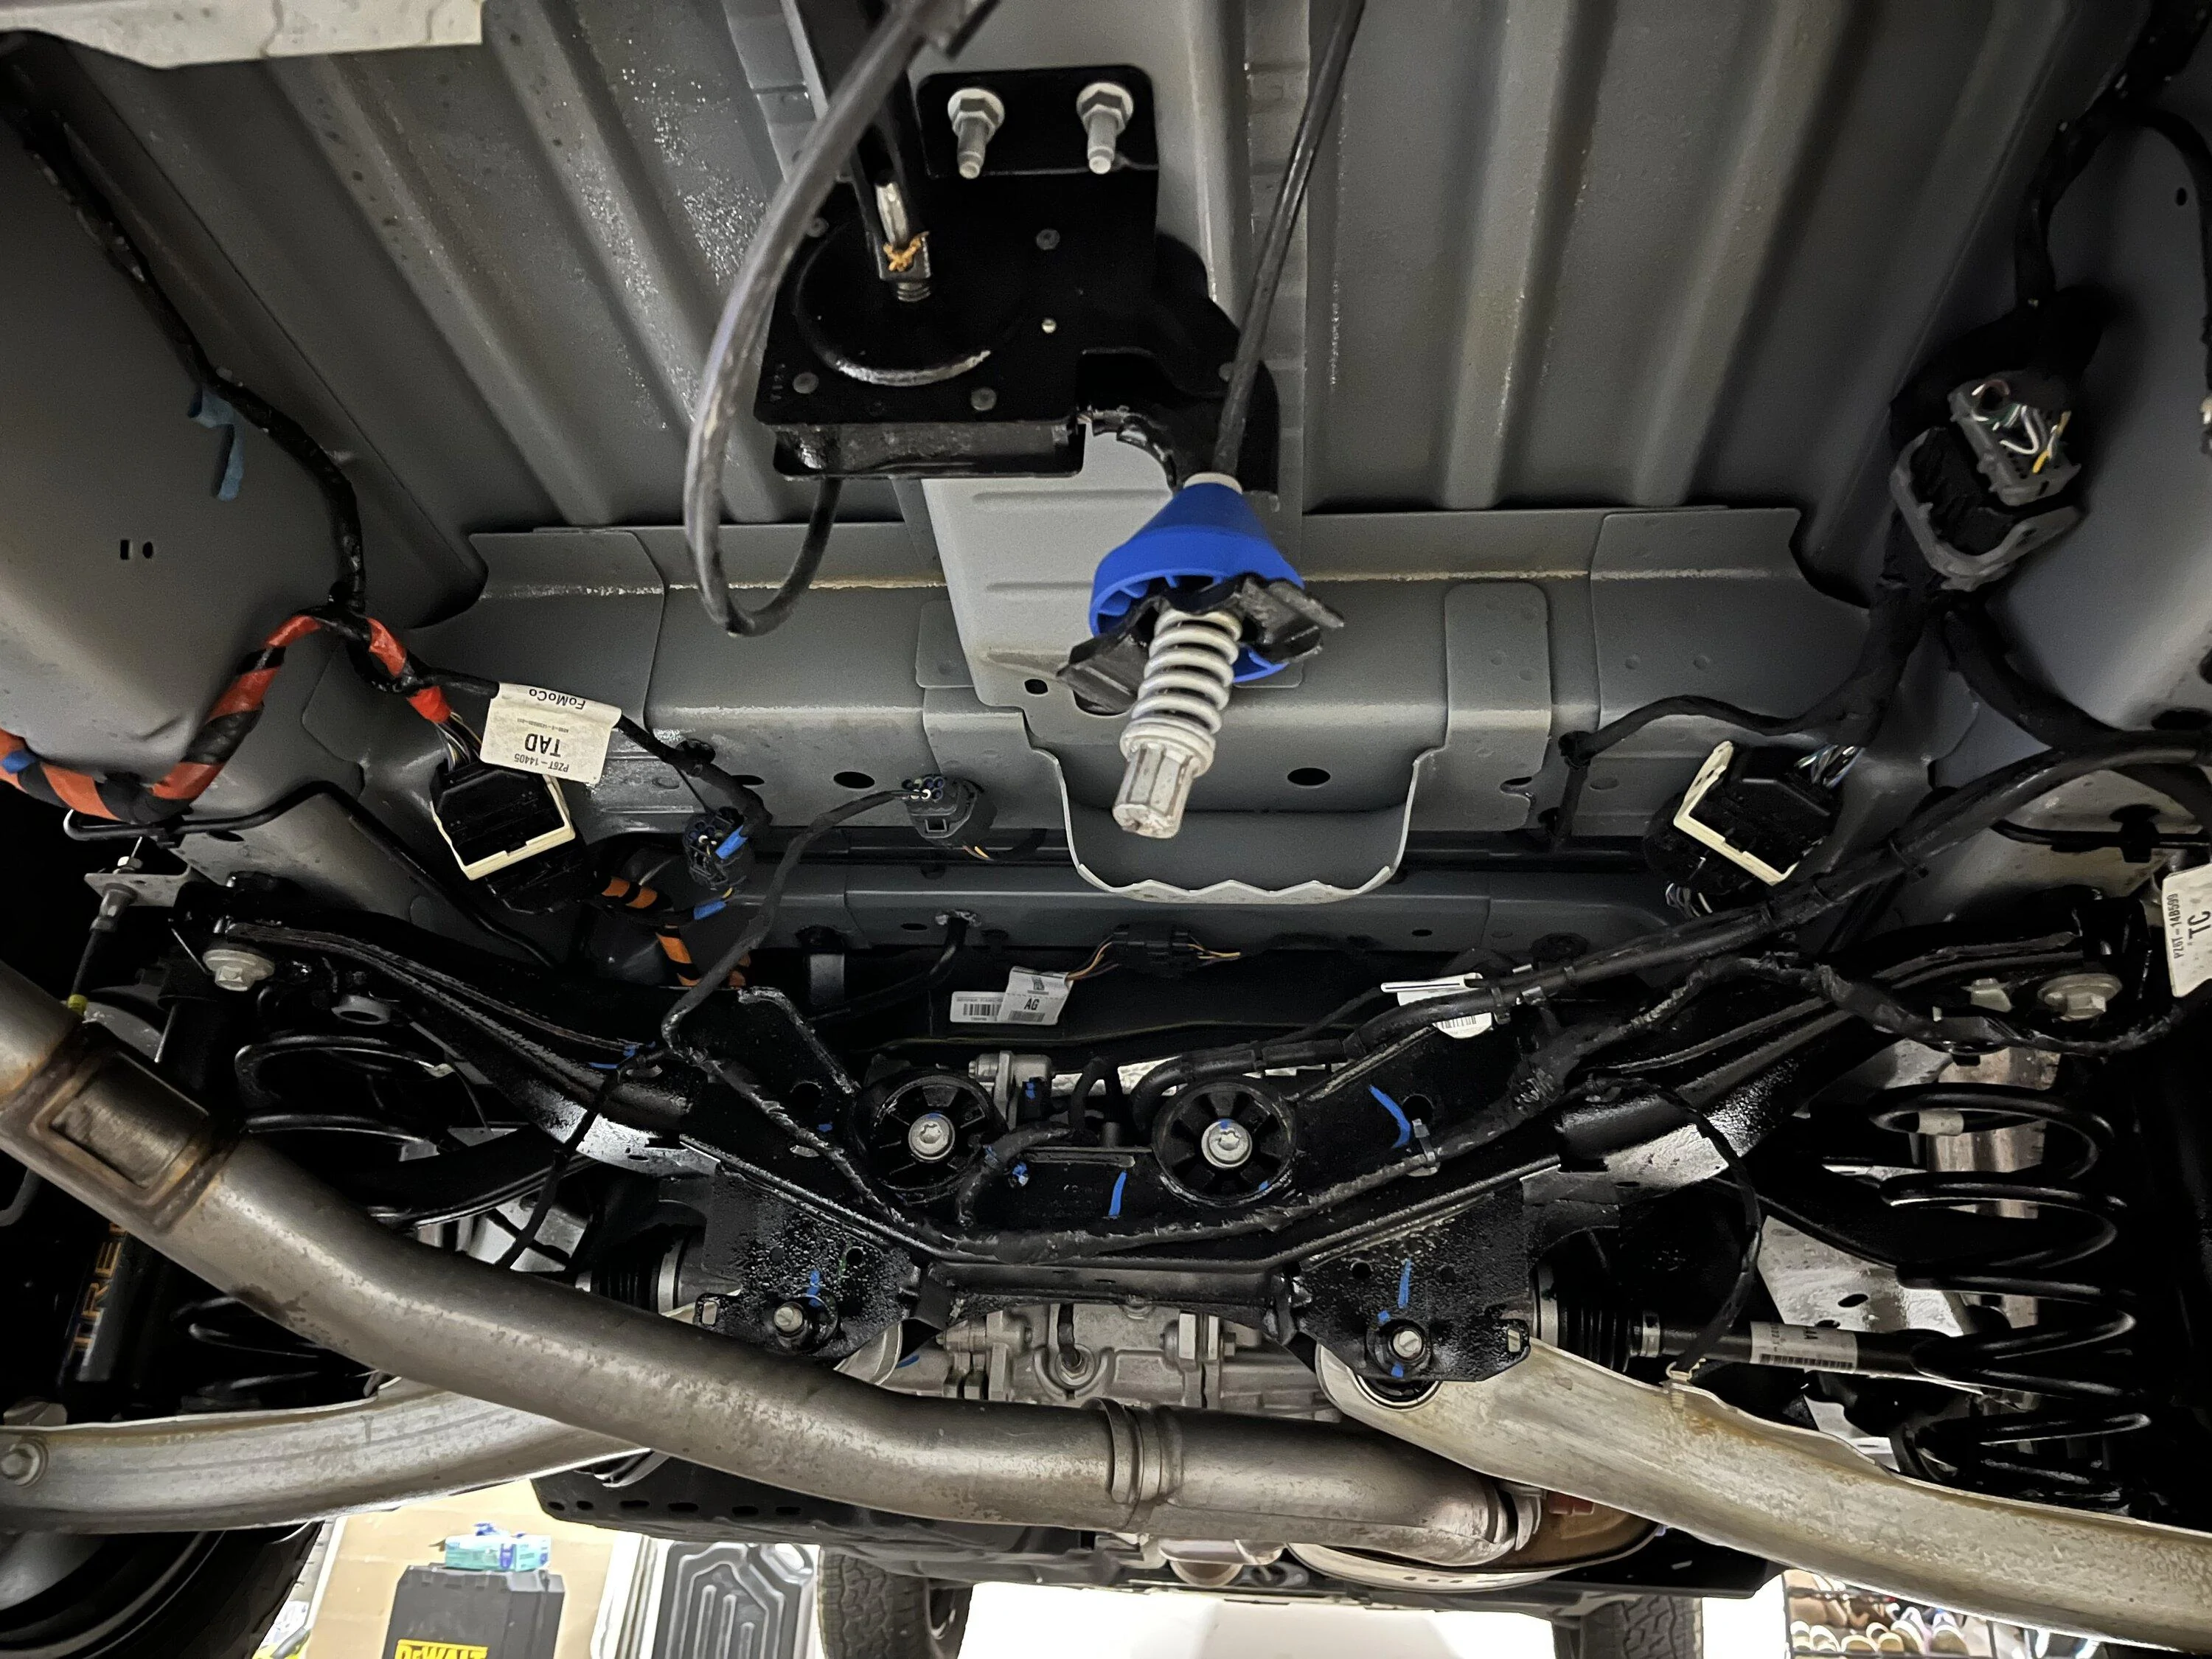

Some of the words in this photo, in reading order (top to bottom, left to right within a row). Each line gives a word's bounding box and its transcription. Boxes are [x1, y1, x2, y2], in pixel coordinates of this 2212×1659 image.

[529, 688, 586, 710] FoMoCo
[524, 733, 561, 758] TAD
[2187, 911, 2211, 940] TC
[1023, 997, 1040, 1011] AG
